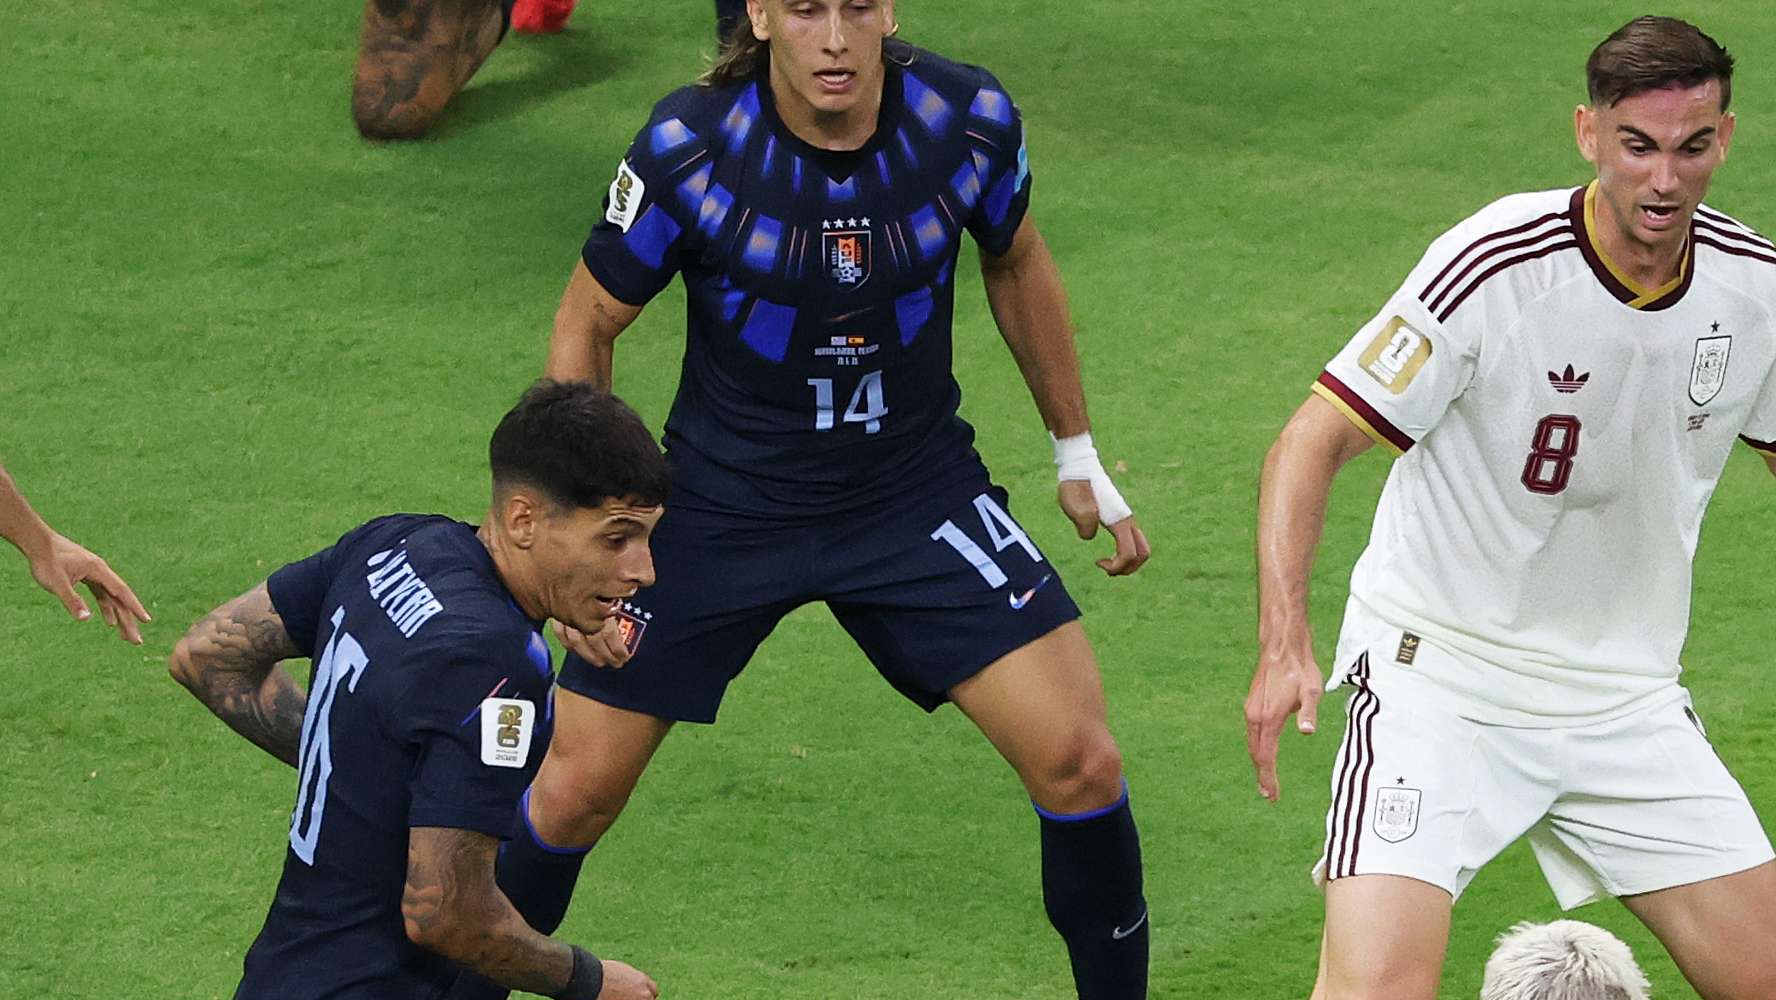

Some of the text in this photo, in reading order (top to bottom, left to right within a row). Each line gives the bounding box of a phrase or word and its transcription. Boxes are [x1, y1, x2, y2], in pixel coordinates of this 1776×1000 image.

[807, 369, 889, 434] 14
[1521, 413, 1582, 496] 8
[930, 493, 1043, 590] 14
